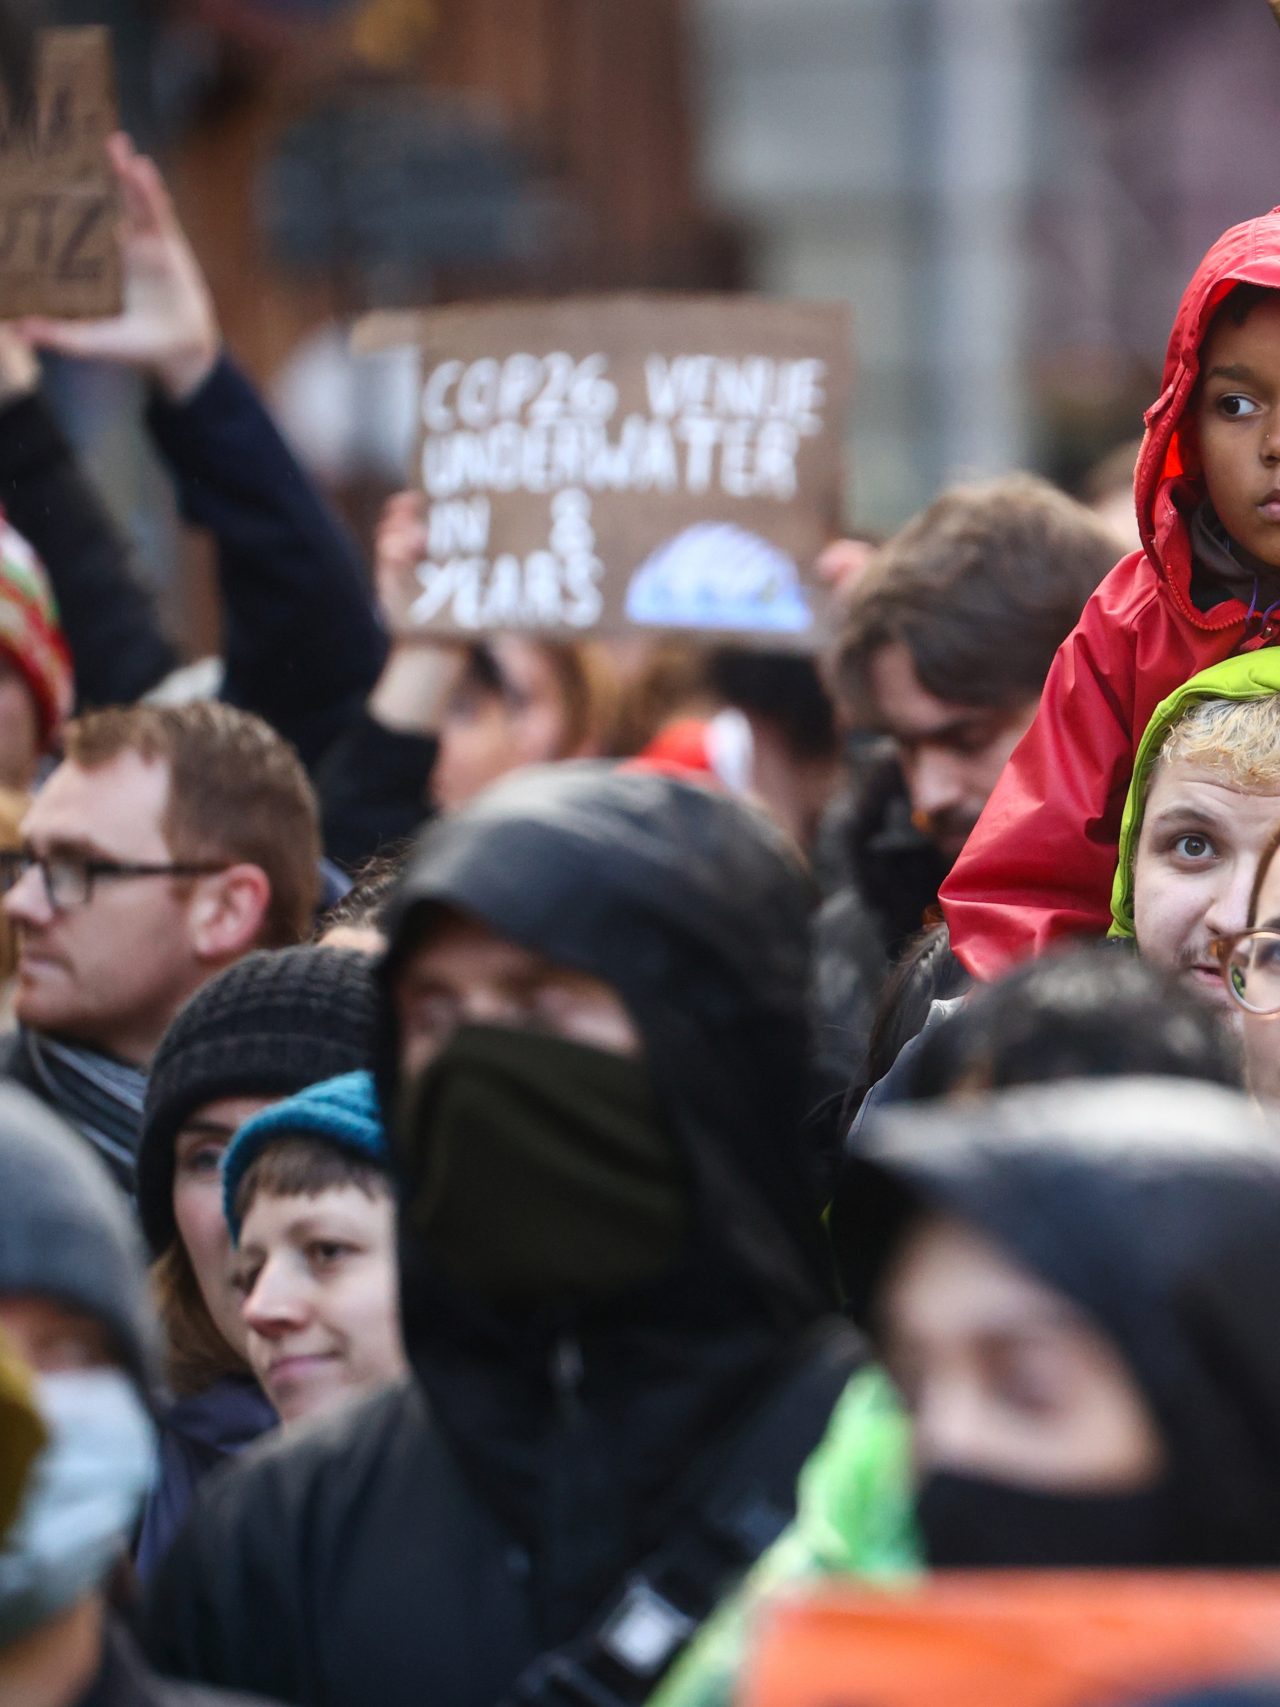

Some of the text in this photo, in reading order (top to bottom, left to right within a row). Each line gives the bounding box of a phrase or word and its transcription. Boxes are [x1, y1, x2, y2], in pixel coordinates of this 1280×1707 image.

[421, 352, 827, 436] COP26 VENUE
[421, 413, 799, 500] UNDERWATER
[427, 488, 595, 559] IN 8
[408, 550, 603, 629] YEARS
